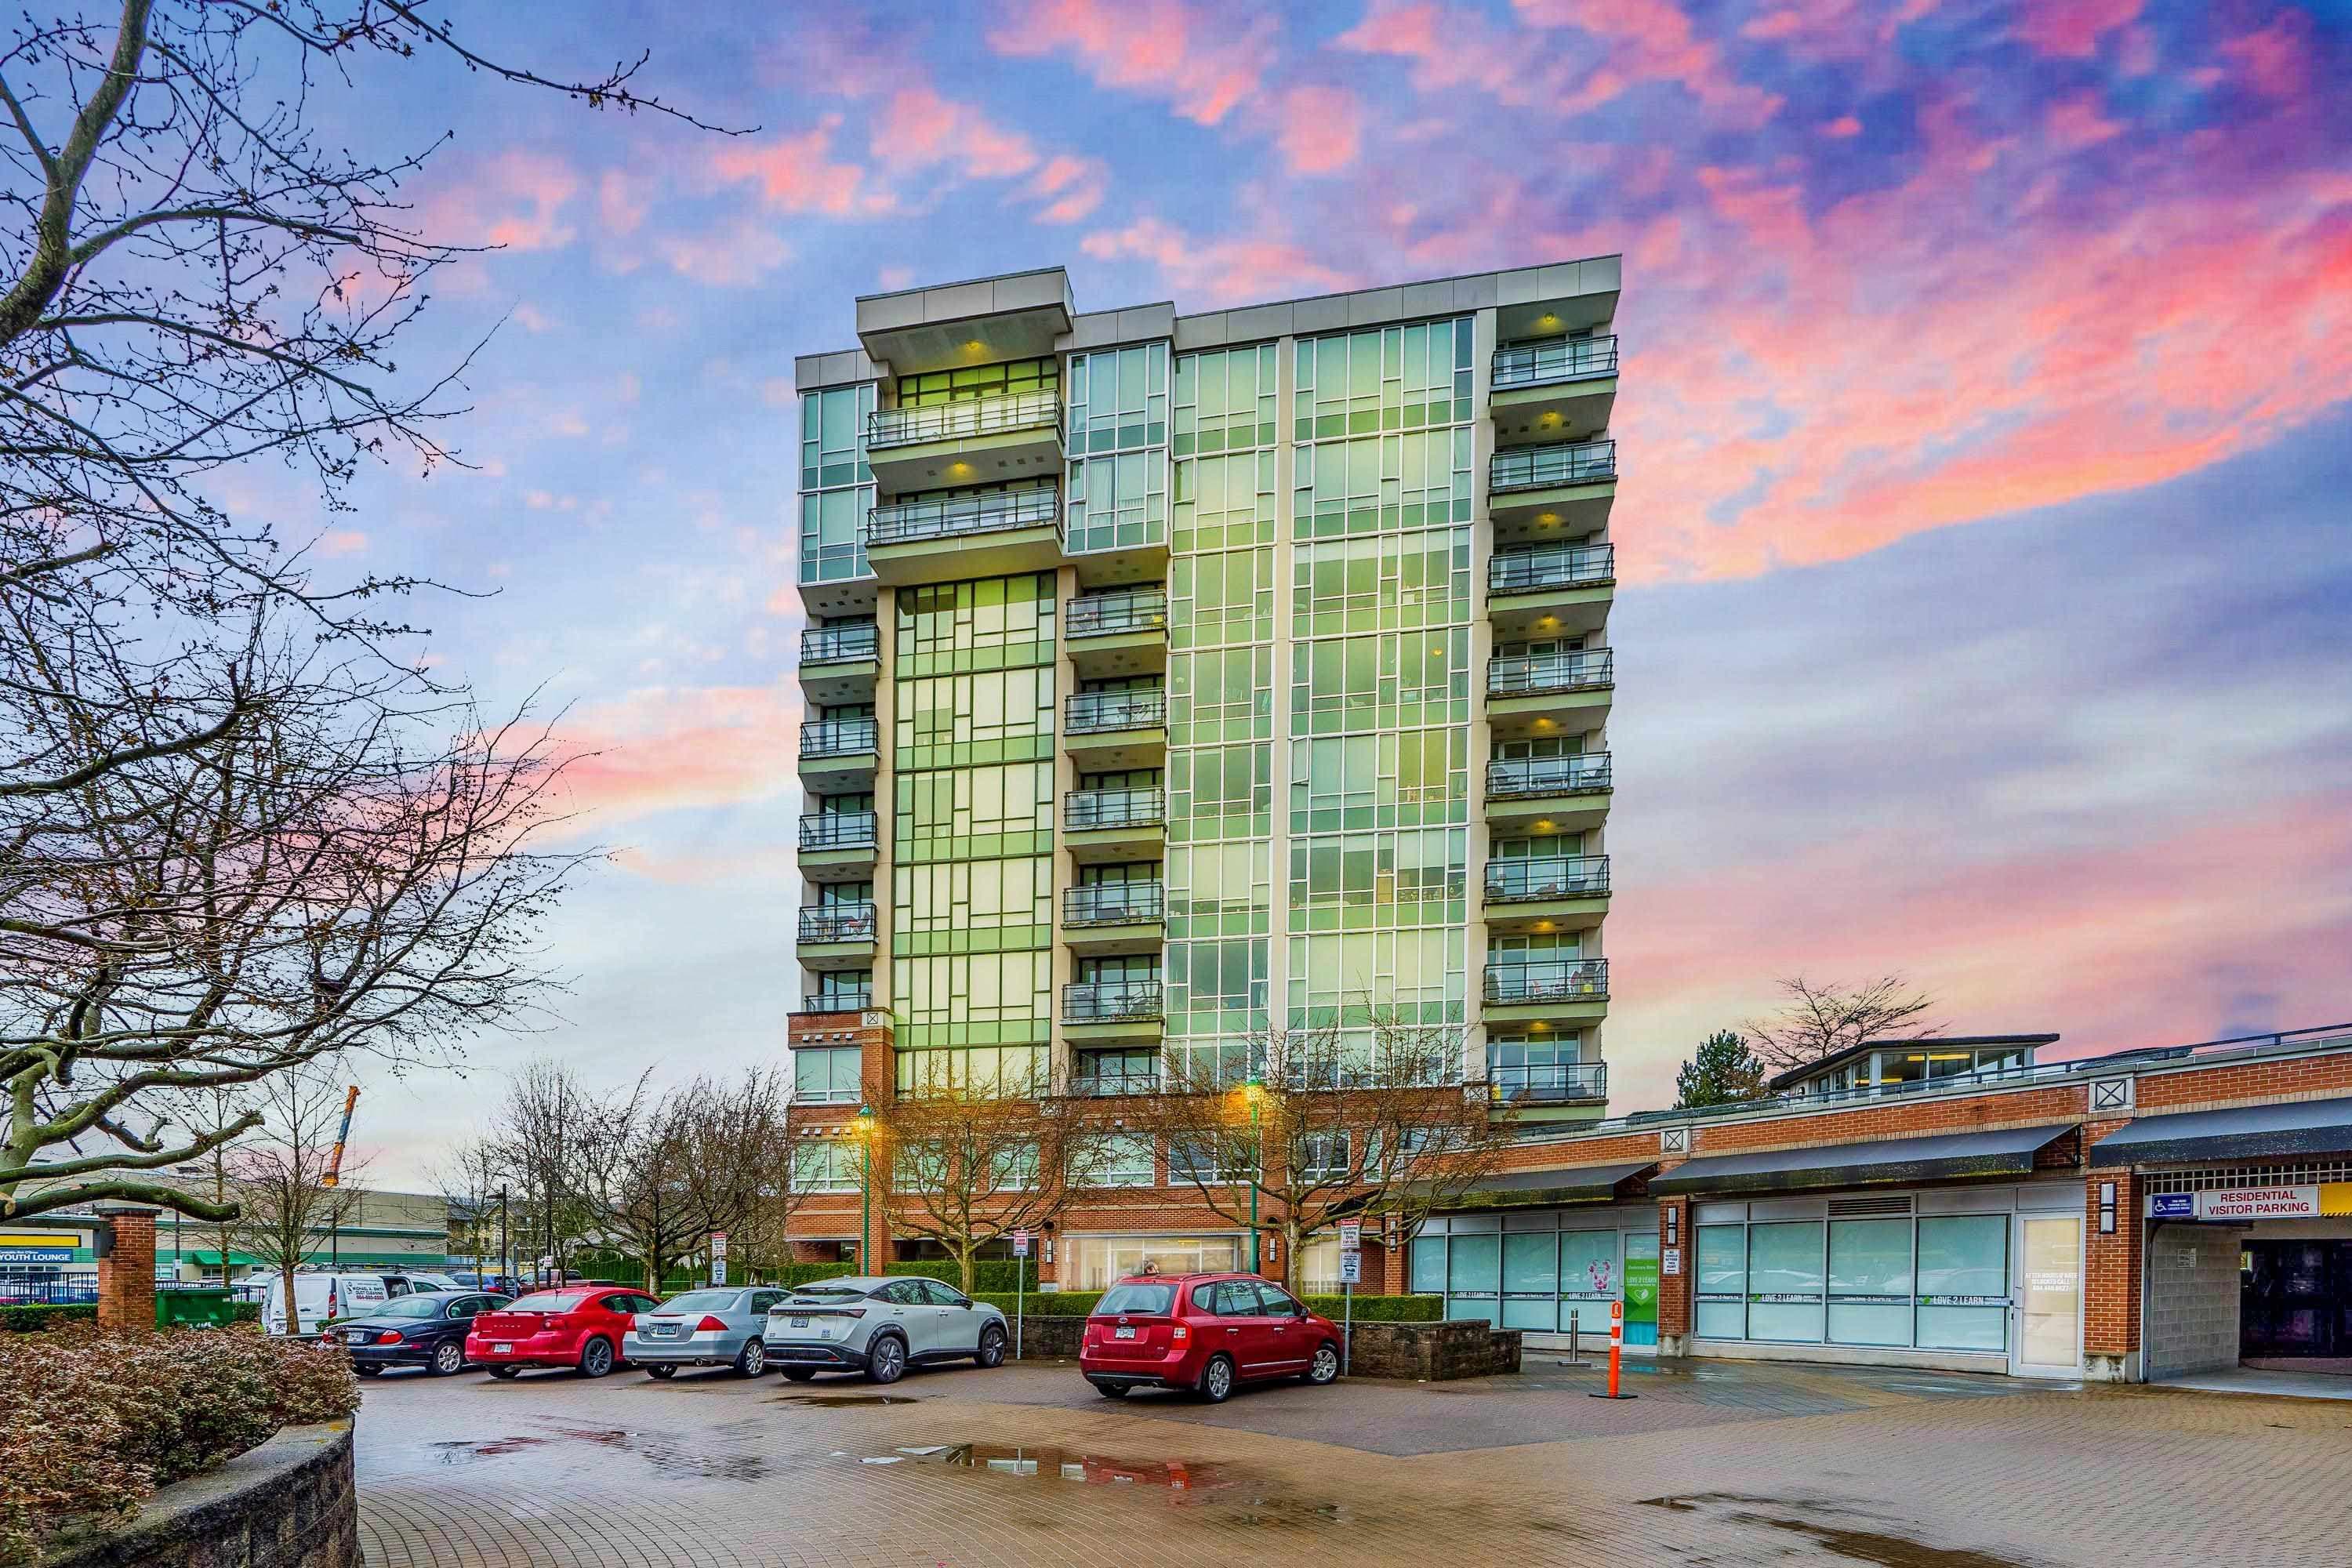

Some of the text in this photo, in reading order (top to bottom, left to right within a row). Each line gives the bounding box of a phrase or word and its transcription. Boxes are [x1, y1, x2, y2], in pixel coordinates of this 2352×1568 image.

[2220, 1190, 2297, 1203] RESIDENTIAL
[2209, 1202, 2310, 1215] VISITOR PARKING
